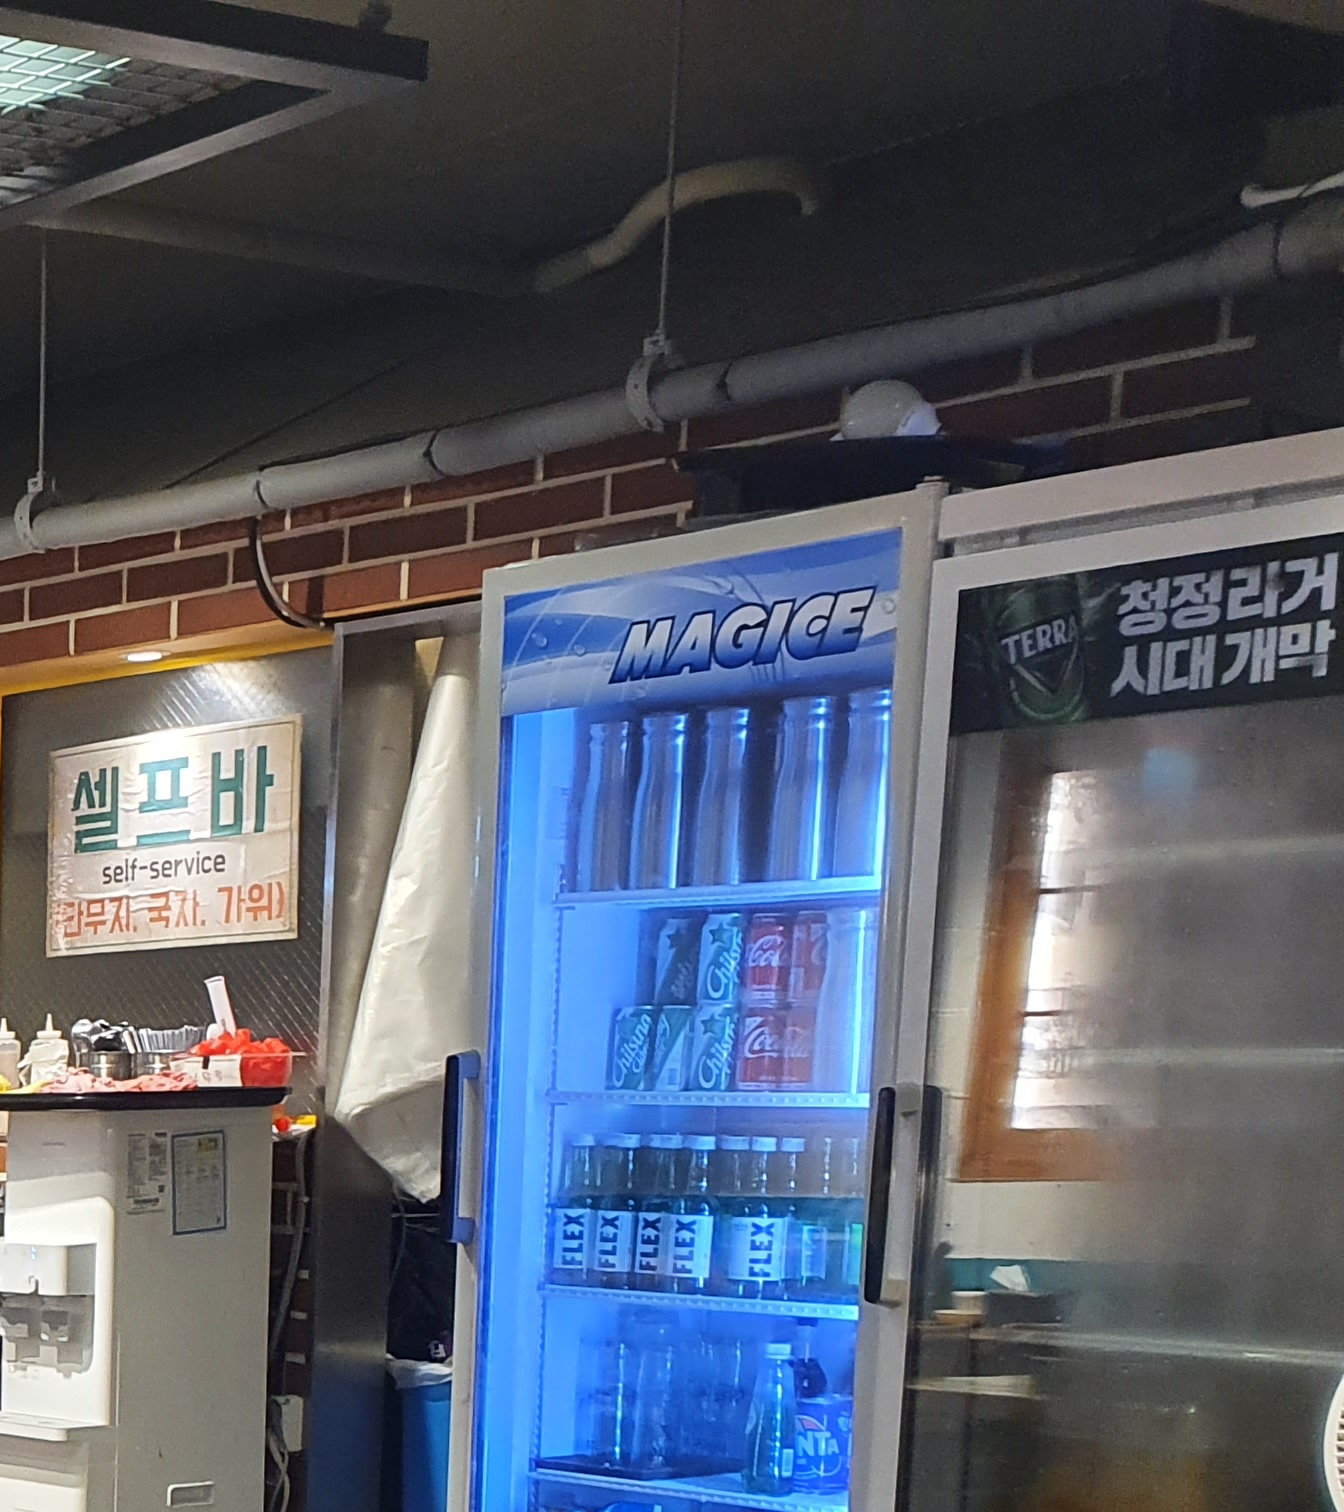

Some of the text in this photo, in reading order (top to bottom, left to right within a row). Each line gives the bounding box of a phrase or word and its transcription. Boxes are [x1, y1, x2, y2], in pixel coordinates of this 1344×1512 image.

[1117, 552, 1340, 637] 청정라거
[608, 586, 877, 685] MAGICE
[1000, 614, 1080, 665] TERRA
[1110, 620, 1337, 698] 시대 개막
[71, 746, 275, 853] 셀프바
[102, 851, 227, 885] self-service
[217, 880, 287, 924] 가위)
[561, 1213, 587, 1267] FLEX
[597, 1214, 620, 1271] FLEX
[639, 1216, 662, 1272] FLEX
[672, 1218, 698, 1275] FLEX
[748, 1221, 776, 1279] FLEX
